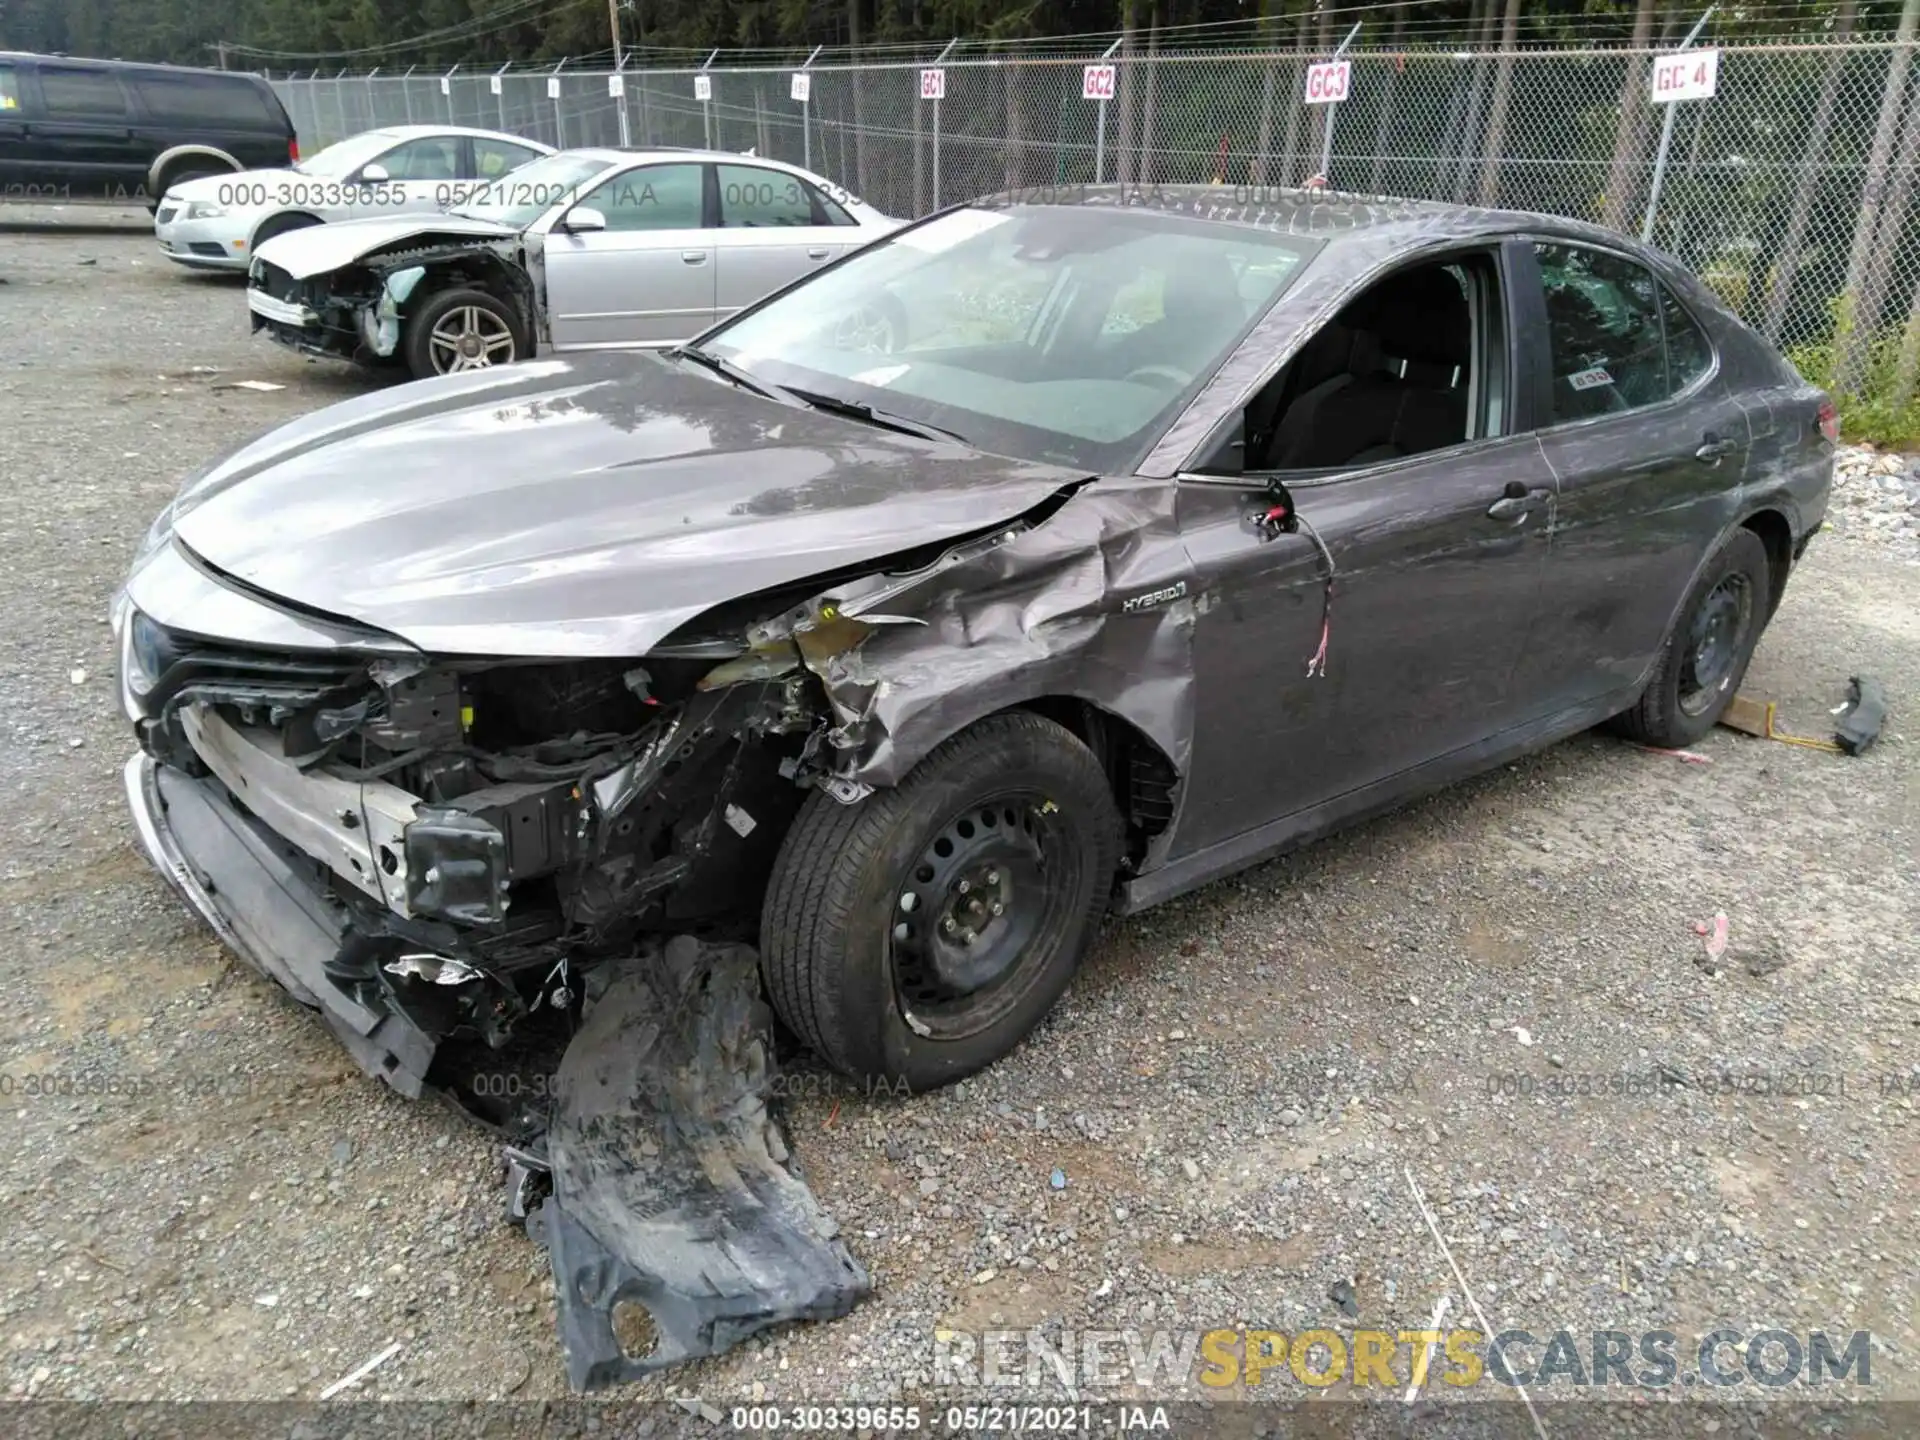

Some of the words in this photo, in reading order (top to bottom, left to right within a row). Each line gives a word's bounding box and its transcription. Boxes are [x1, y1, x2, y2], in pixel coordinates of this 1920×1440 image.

[922, 73, 943, 95] GC1
[1086, 70, 1112, 94] GC2
[1310, 66, 1347, 97] GC3
[1657, 64, 1686, 91] GC
[1693, 61, 1707, 86] 4
